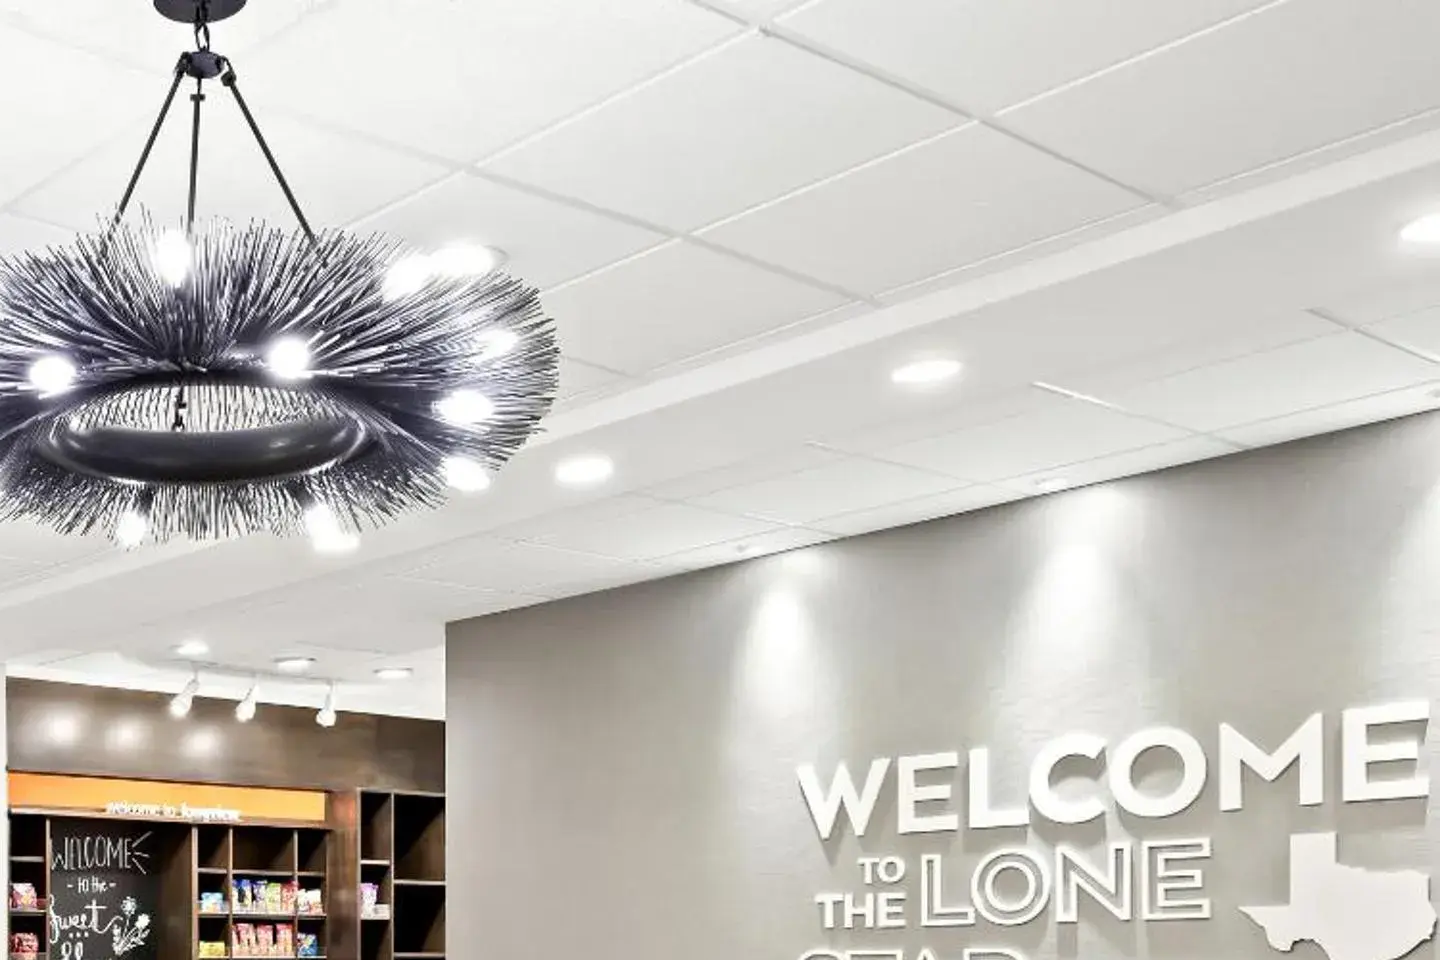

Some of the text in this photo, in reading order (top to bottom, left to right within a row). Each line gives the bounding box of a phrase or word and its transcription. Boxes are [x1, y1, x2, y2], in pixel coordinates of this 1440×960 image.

[796, 700, 1429, 840] WELCOME
[50, 836, 132, 870] WELCOME
[814, 837, 1211, 928] THE LONE
[857, 855, 905, 884] TO
